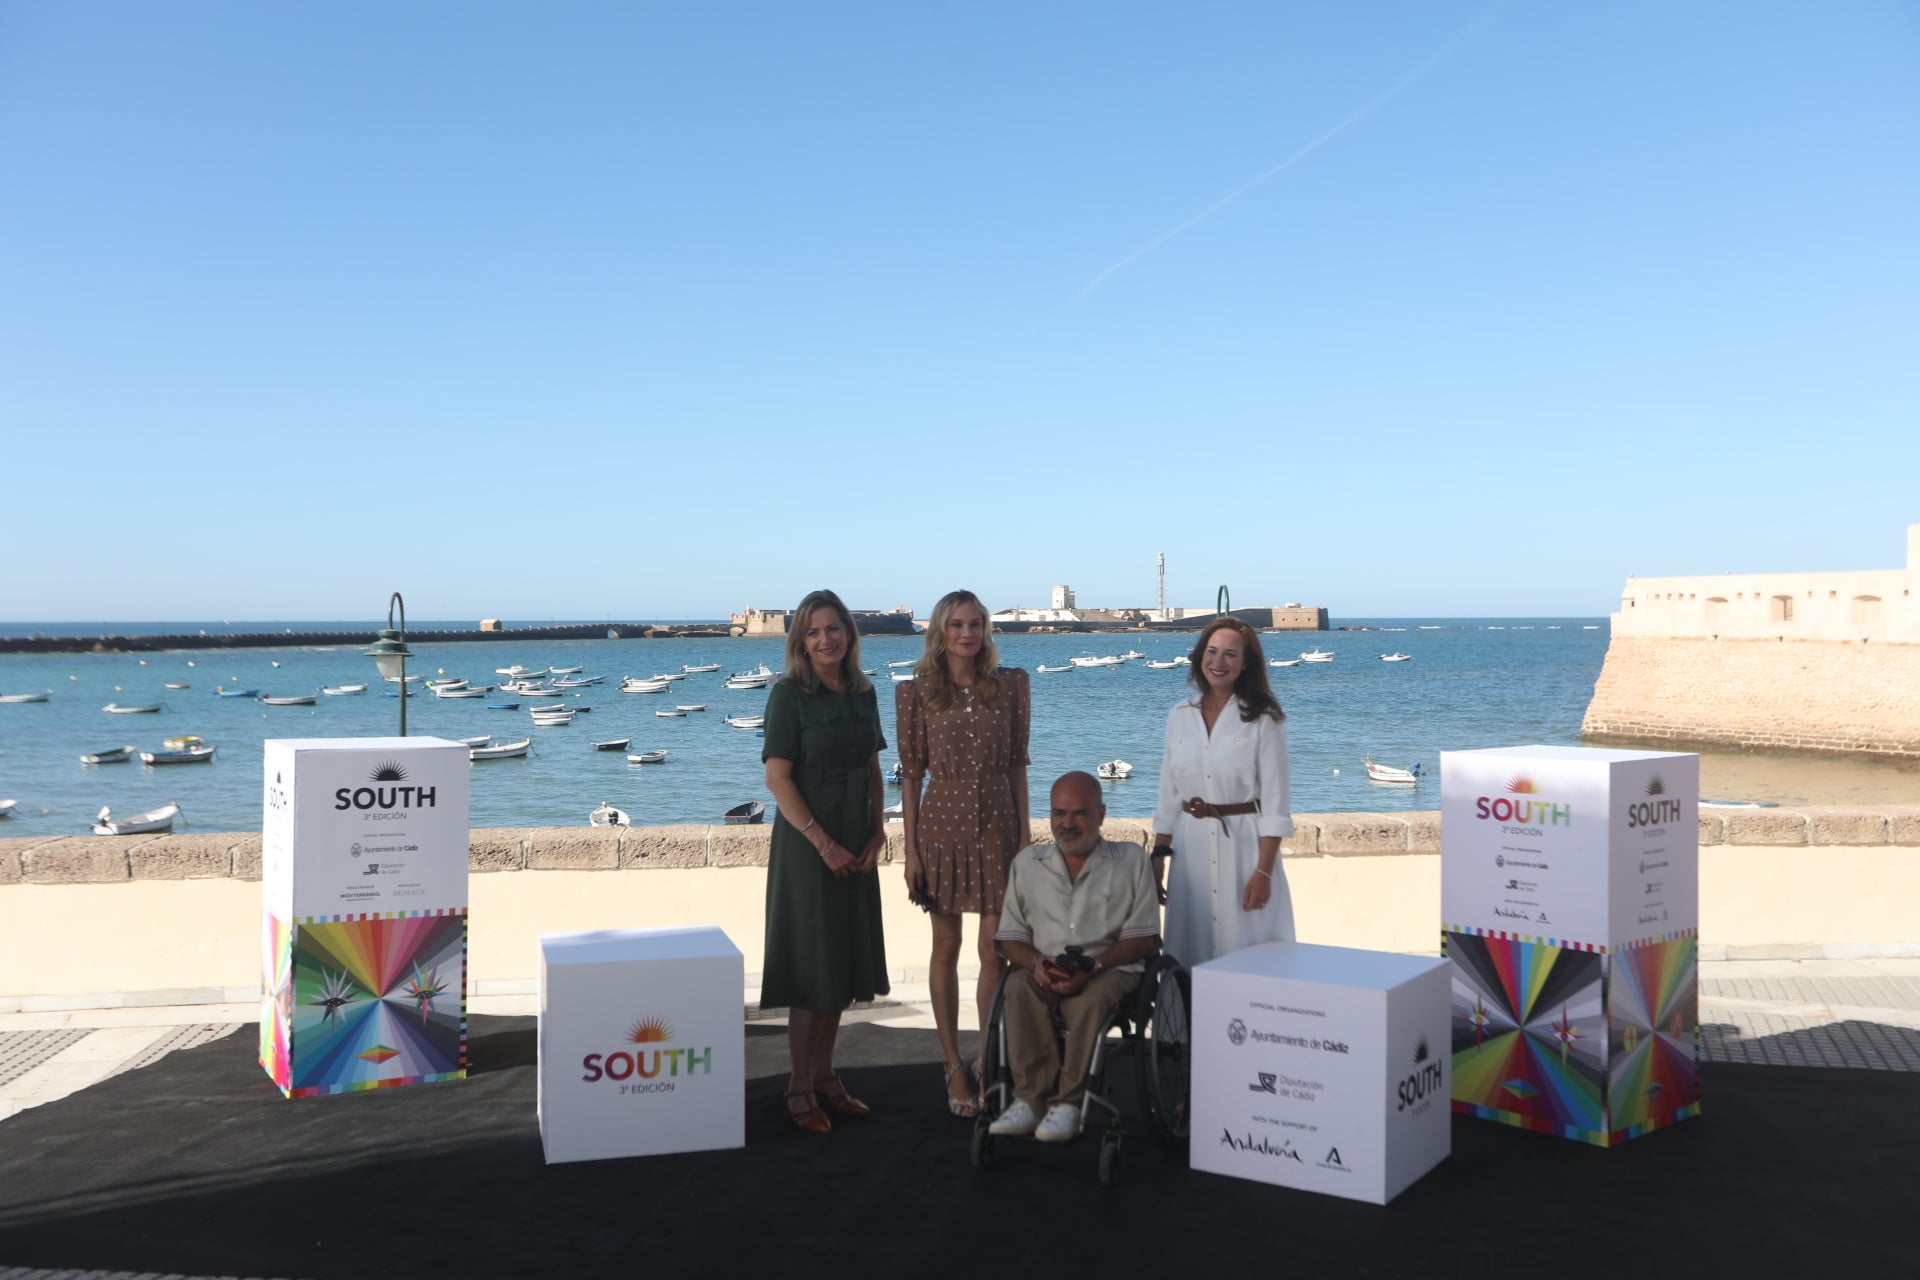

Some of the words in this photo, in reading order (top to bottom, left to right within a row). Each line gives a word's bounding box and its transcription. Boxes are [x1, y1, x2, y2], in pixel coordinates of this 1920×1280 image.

[334, 786, 436, 810] SOUTH
[372, 811, 407, 821] EDICIÓN
[1476, 796, 1571, 827] SOUTH
[1628, 798, 1681, 828] SOUTH
[1251, 1028, 1308, 1049] Ayuntamiento
[1310, 1038, 1321, 1050] de
[1322, 1039, 1349, 1054] Cádiz
[582, 1046, 712, 1083] SOUTH
[631, 1082, 675, 1095] EDICIÓN
[1280, 1074, 1324, 1091] Diputación
[1280, 1088, 1290, 1097] de
[1397, 1058, 1442, 1113] SOUTH
